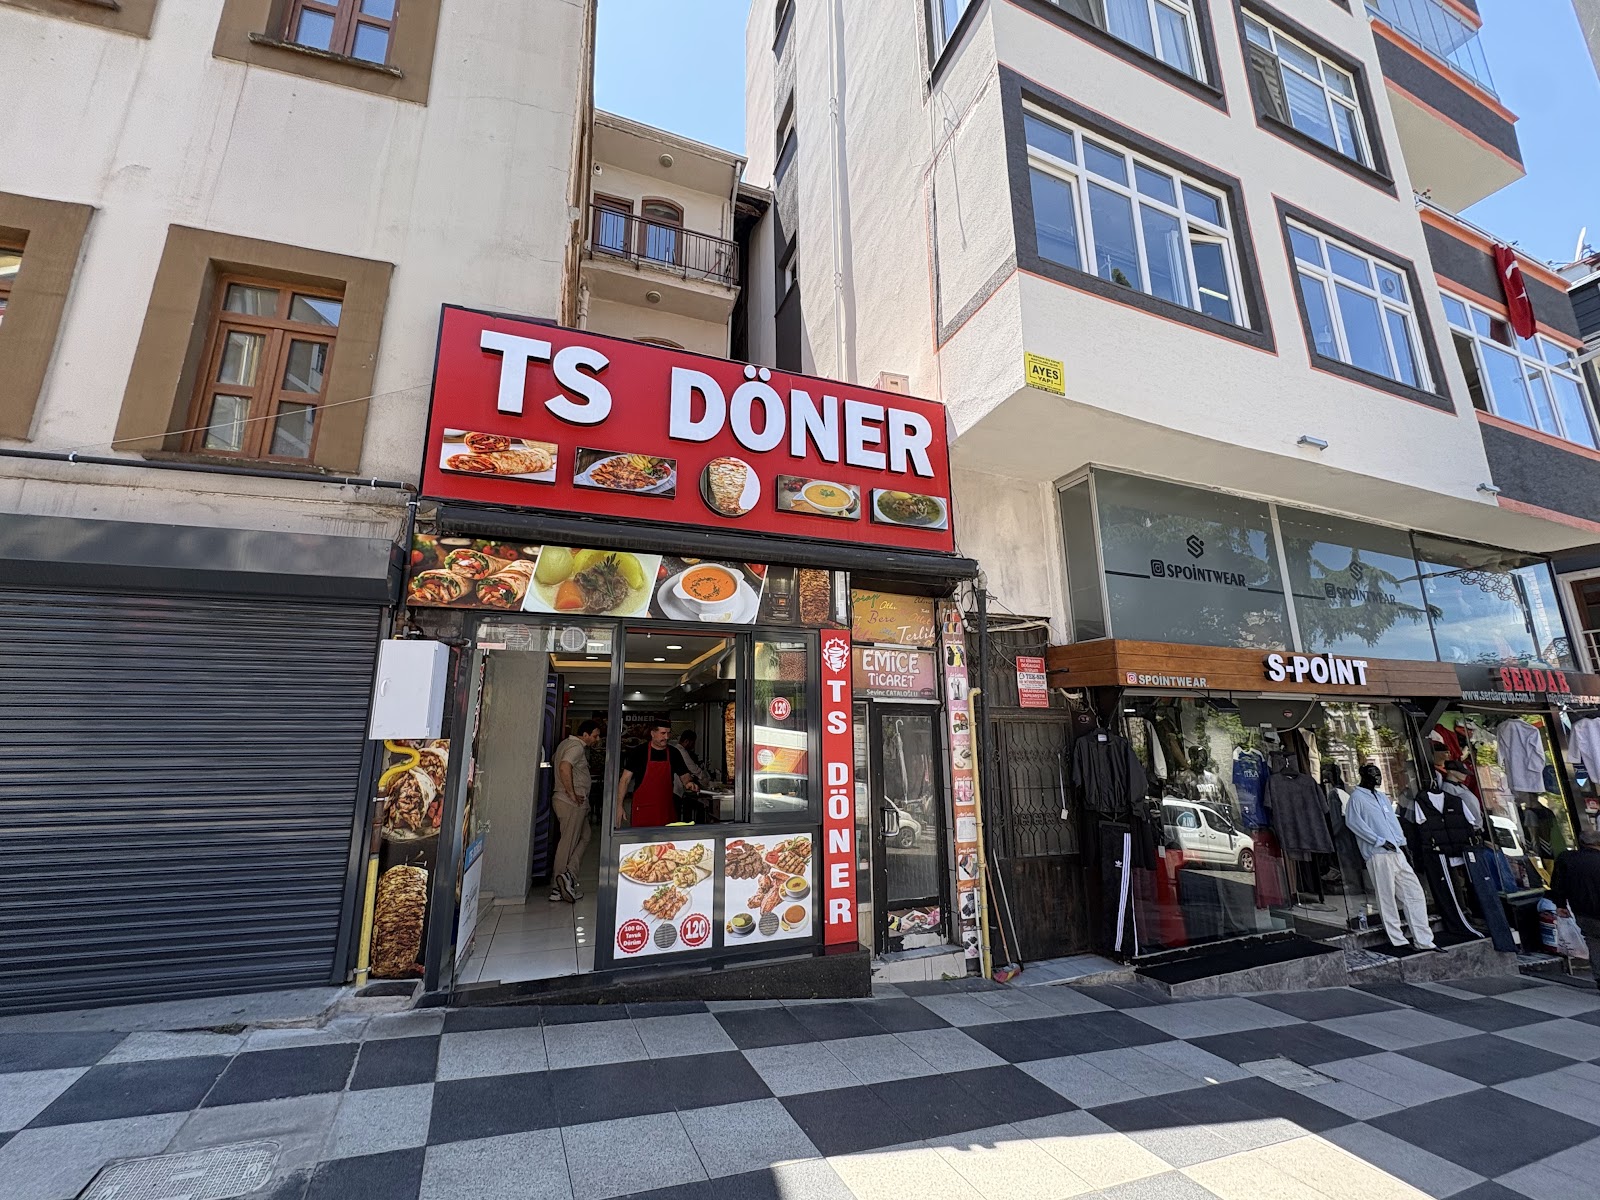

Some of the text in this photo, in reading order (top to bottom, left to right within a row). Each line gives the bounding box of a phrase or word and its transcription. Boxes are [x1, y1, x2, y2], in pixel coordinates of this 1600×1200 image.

[1032, 365, 1059, 380] AYES
[1037, 376, 1053, 384] YAPI
[480, 329, 936, 478] TS DÖNER
[867, 610, 896, 624] Bere
[862, 649, 920, 674] EMİCE
[1267, 653, 1368, 686] S-POİNT
[868, 673, 915, 688] TİCARET
[774, 702, 786, 715] 120
[625, 714, 655, 722] DÖNER
[827, 680, 852, 924] TS DÖNER
[685, 919, 706, 940] 120
[623, 939, 642, 947] Dürüm
